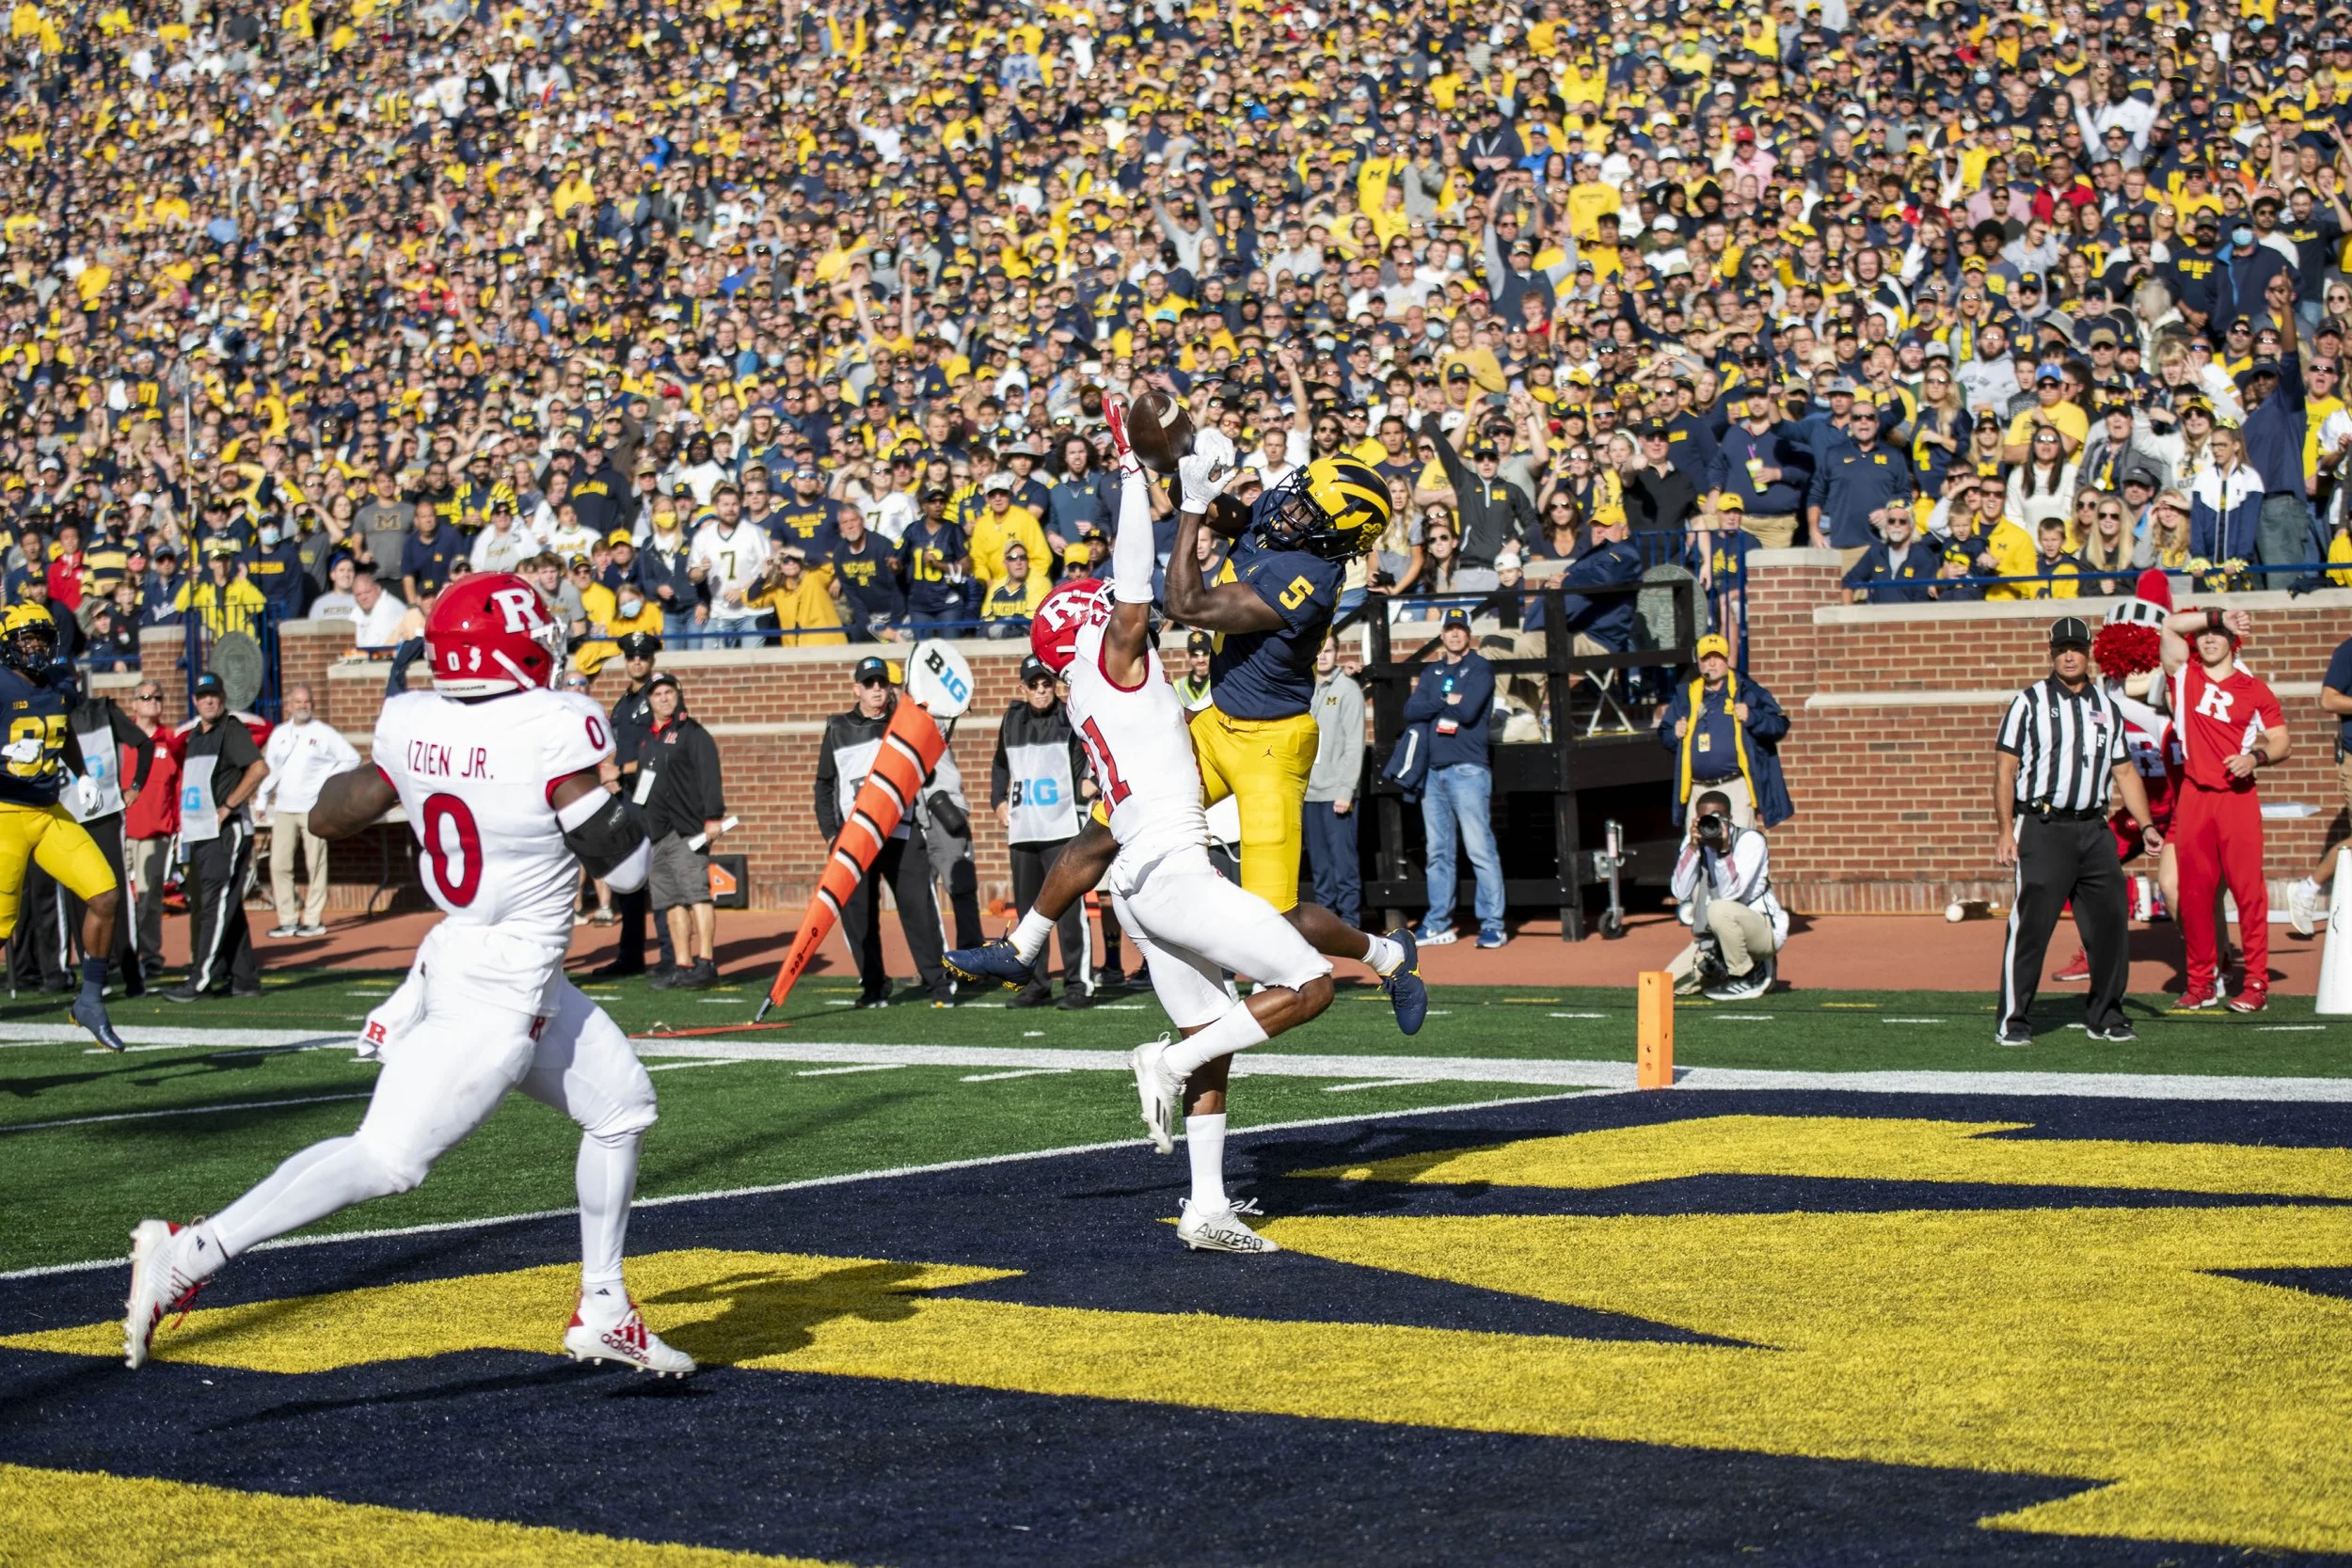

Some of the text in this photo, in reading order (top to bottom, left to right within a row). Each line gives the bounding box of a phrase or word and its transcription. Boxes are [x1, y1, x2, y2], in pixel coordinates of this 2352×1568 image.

[375, 512, 400, 531] M
[720, 550, 737, 581] 7
[1279, 576, 1314, 610] 5
[491, 588, 543, 634] R
[1040, 592, 1087, 633] R
[447, 651, 461, 671] 0
[1327, 697, 1337, 705] M
[2051, 707, 2058, 718] S
[2195, 682, 2234, 723] R
[585, 715, 607, 751] 0
[2097, 734, 2106, 747] F
[408, 740, 495, 780] IZIEN JR.
[423, 793, 483, 908] 0
[367, 1021, 387, 1044] R
[601, 1333, 651, 1365] adidas
